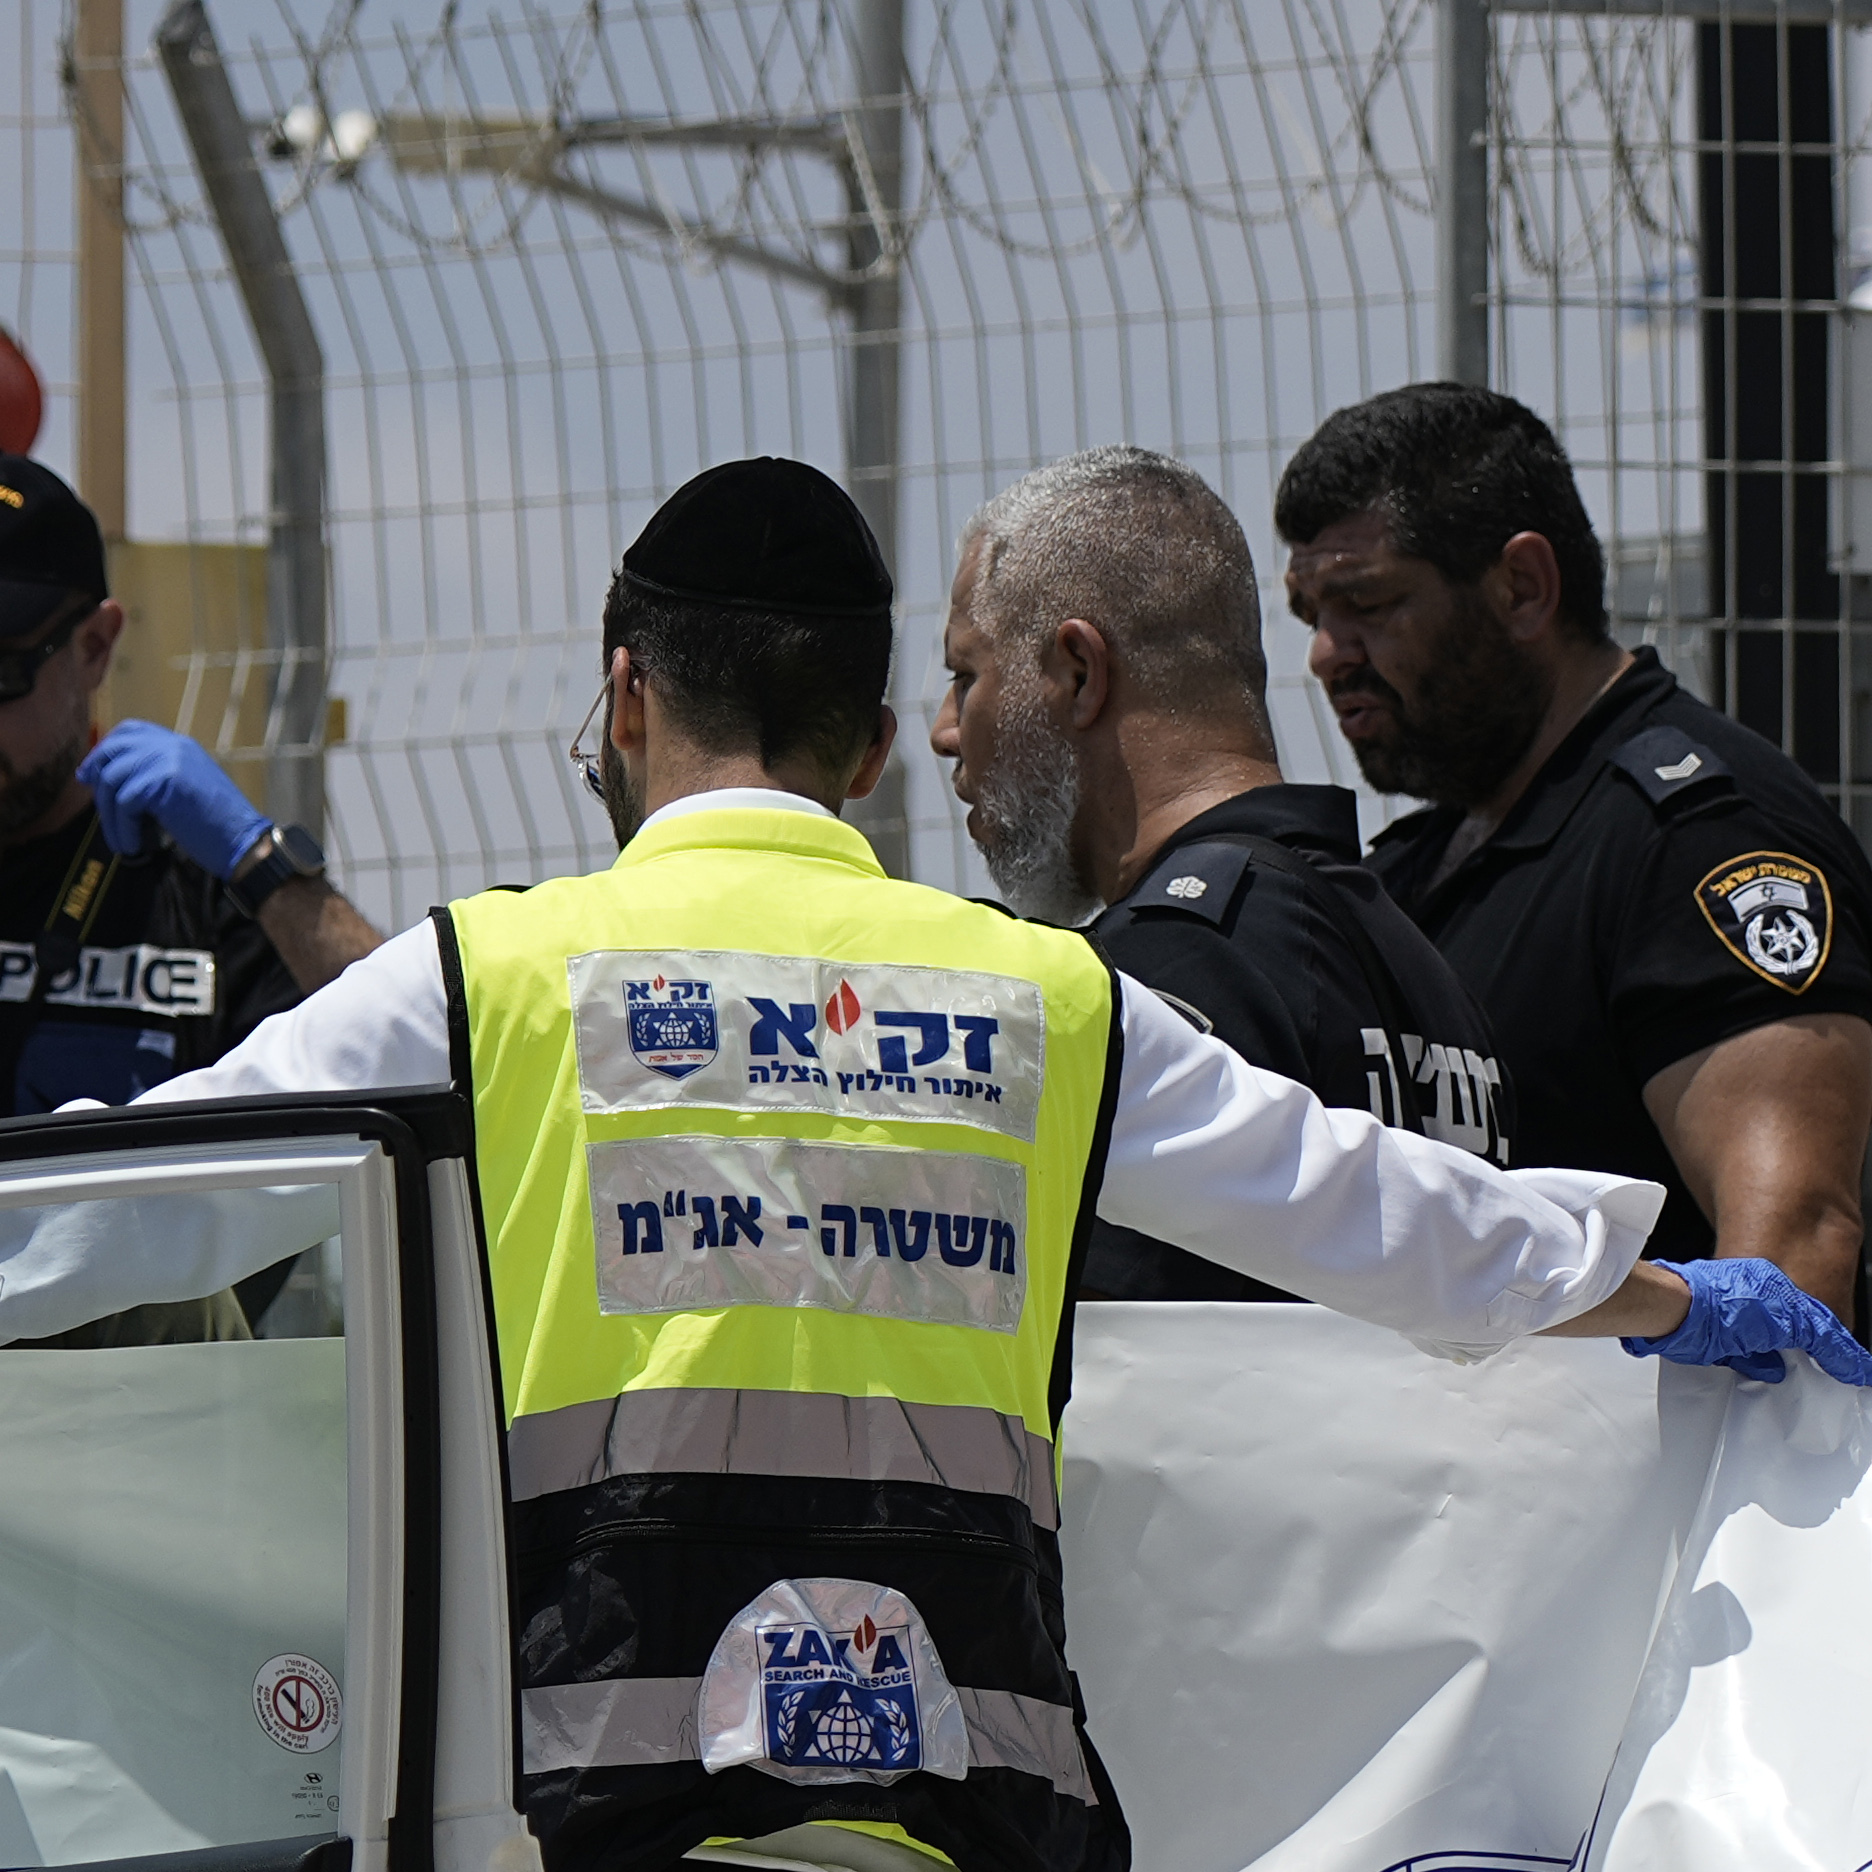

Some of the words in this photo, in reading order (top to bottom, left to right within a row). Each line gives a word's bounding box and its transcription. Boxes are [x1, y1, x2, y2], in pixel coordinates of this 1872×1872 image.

[748, 1061, 828, 1087] הצלה
[836, 1069, 916, 1095] חילוץ
[923, 1075, 1002, 1104] איתור
[821, 1203, 1016, 1275] משטרה
[764, 1668, 824, 1683] SEARCH
[829, 1668, 854, 1683] AND
[856, 1670, 912, 1688] RESCUE
